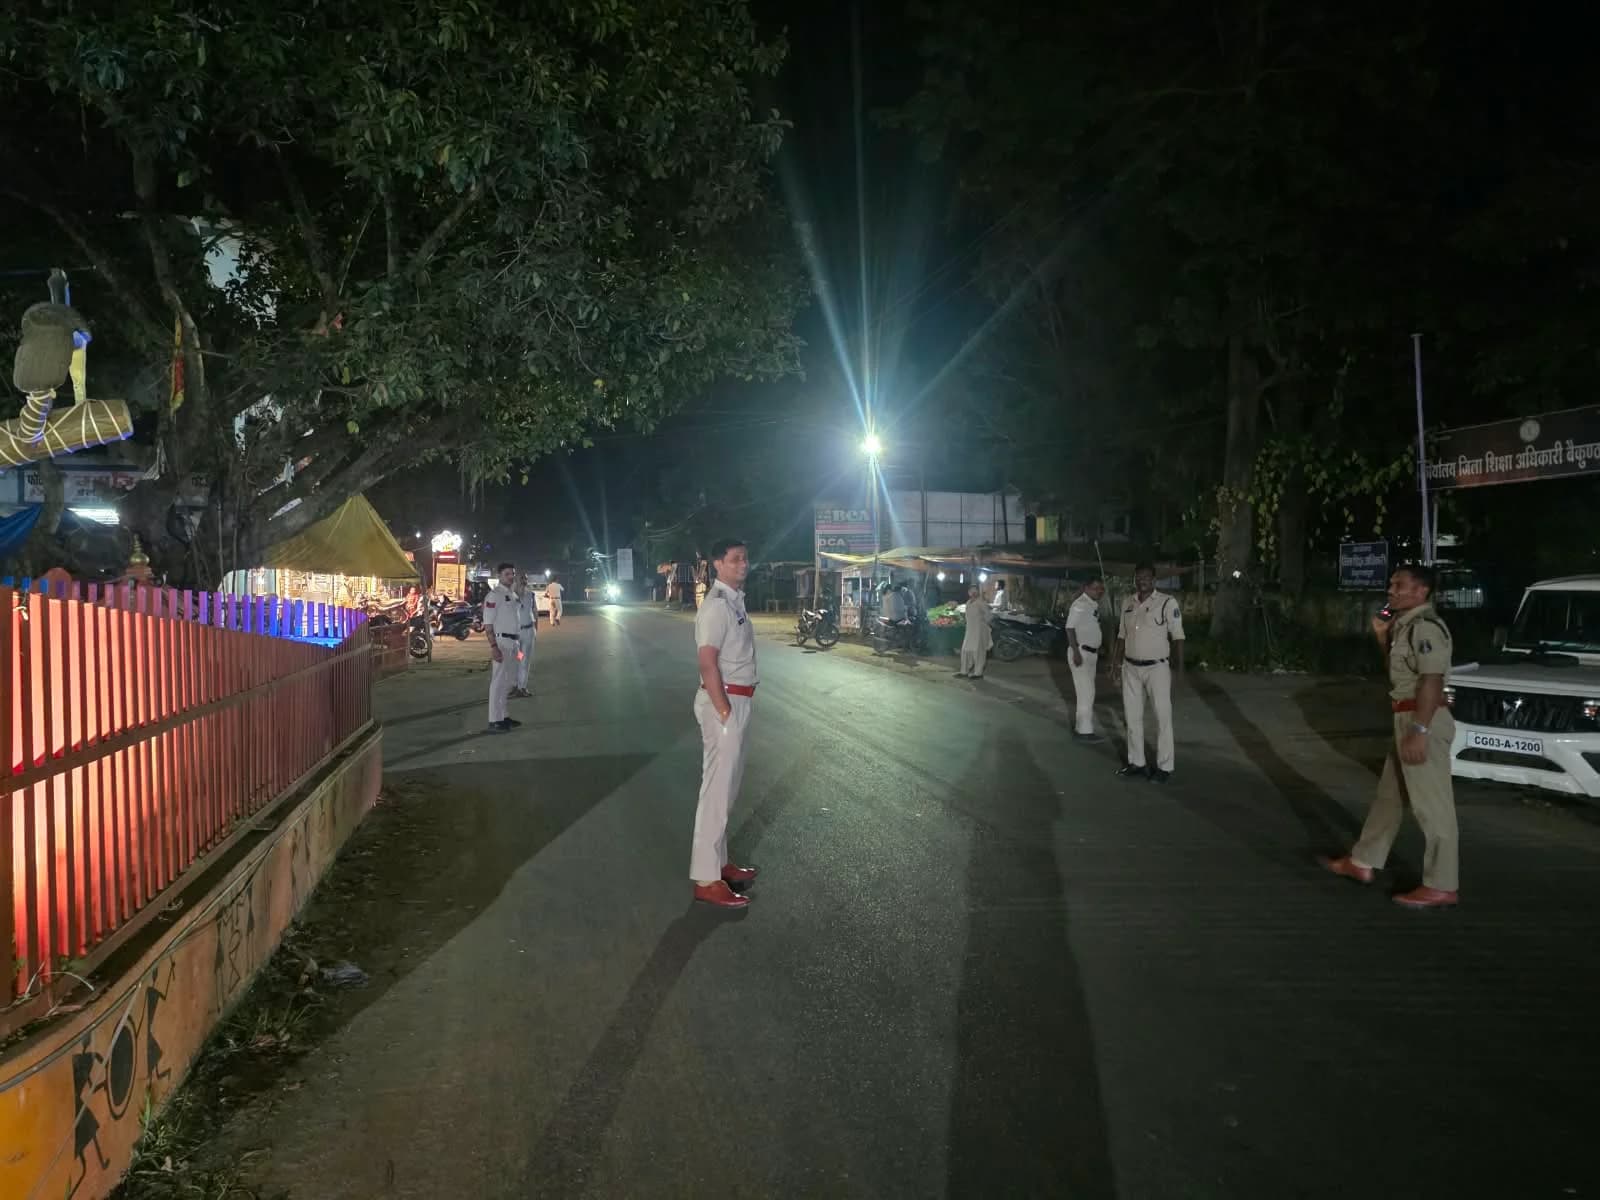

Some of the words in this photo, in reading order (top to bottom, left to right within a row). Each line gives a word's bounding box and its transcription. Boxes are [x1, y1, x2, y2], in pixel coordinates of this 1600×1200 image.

[1458, 454, 1483, 477] जिला
[1485, 450, 1513, 473] शिक्षा
[1515, 440, 1563, 470] अधिकारी
[1474, 735, 1541, 752] CG03-A-1200
